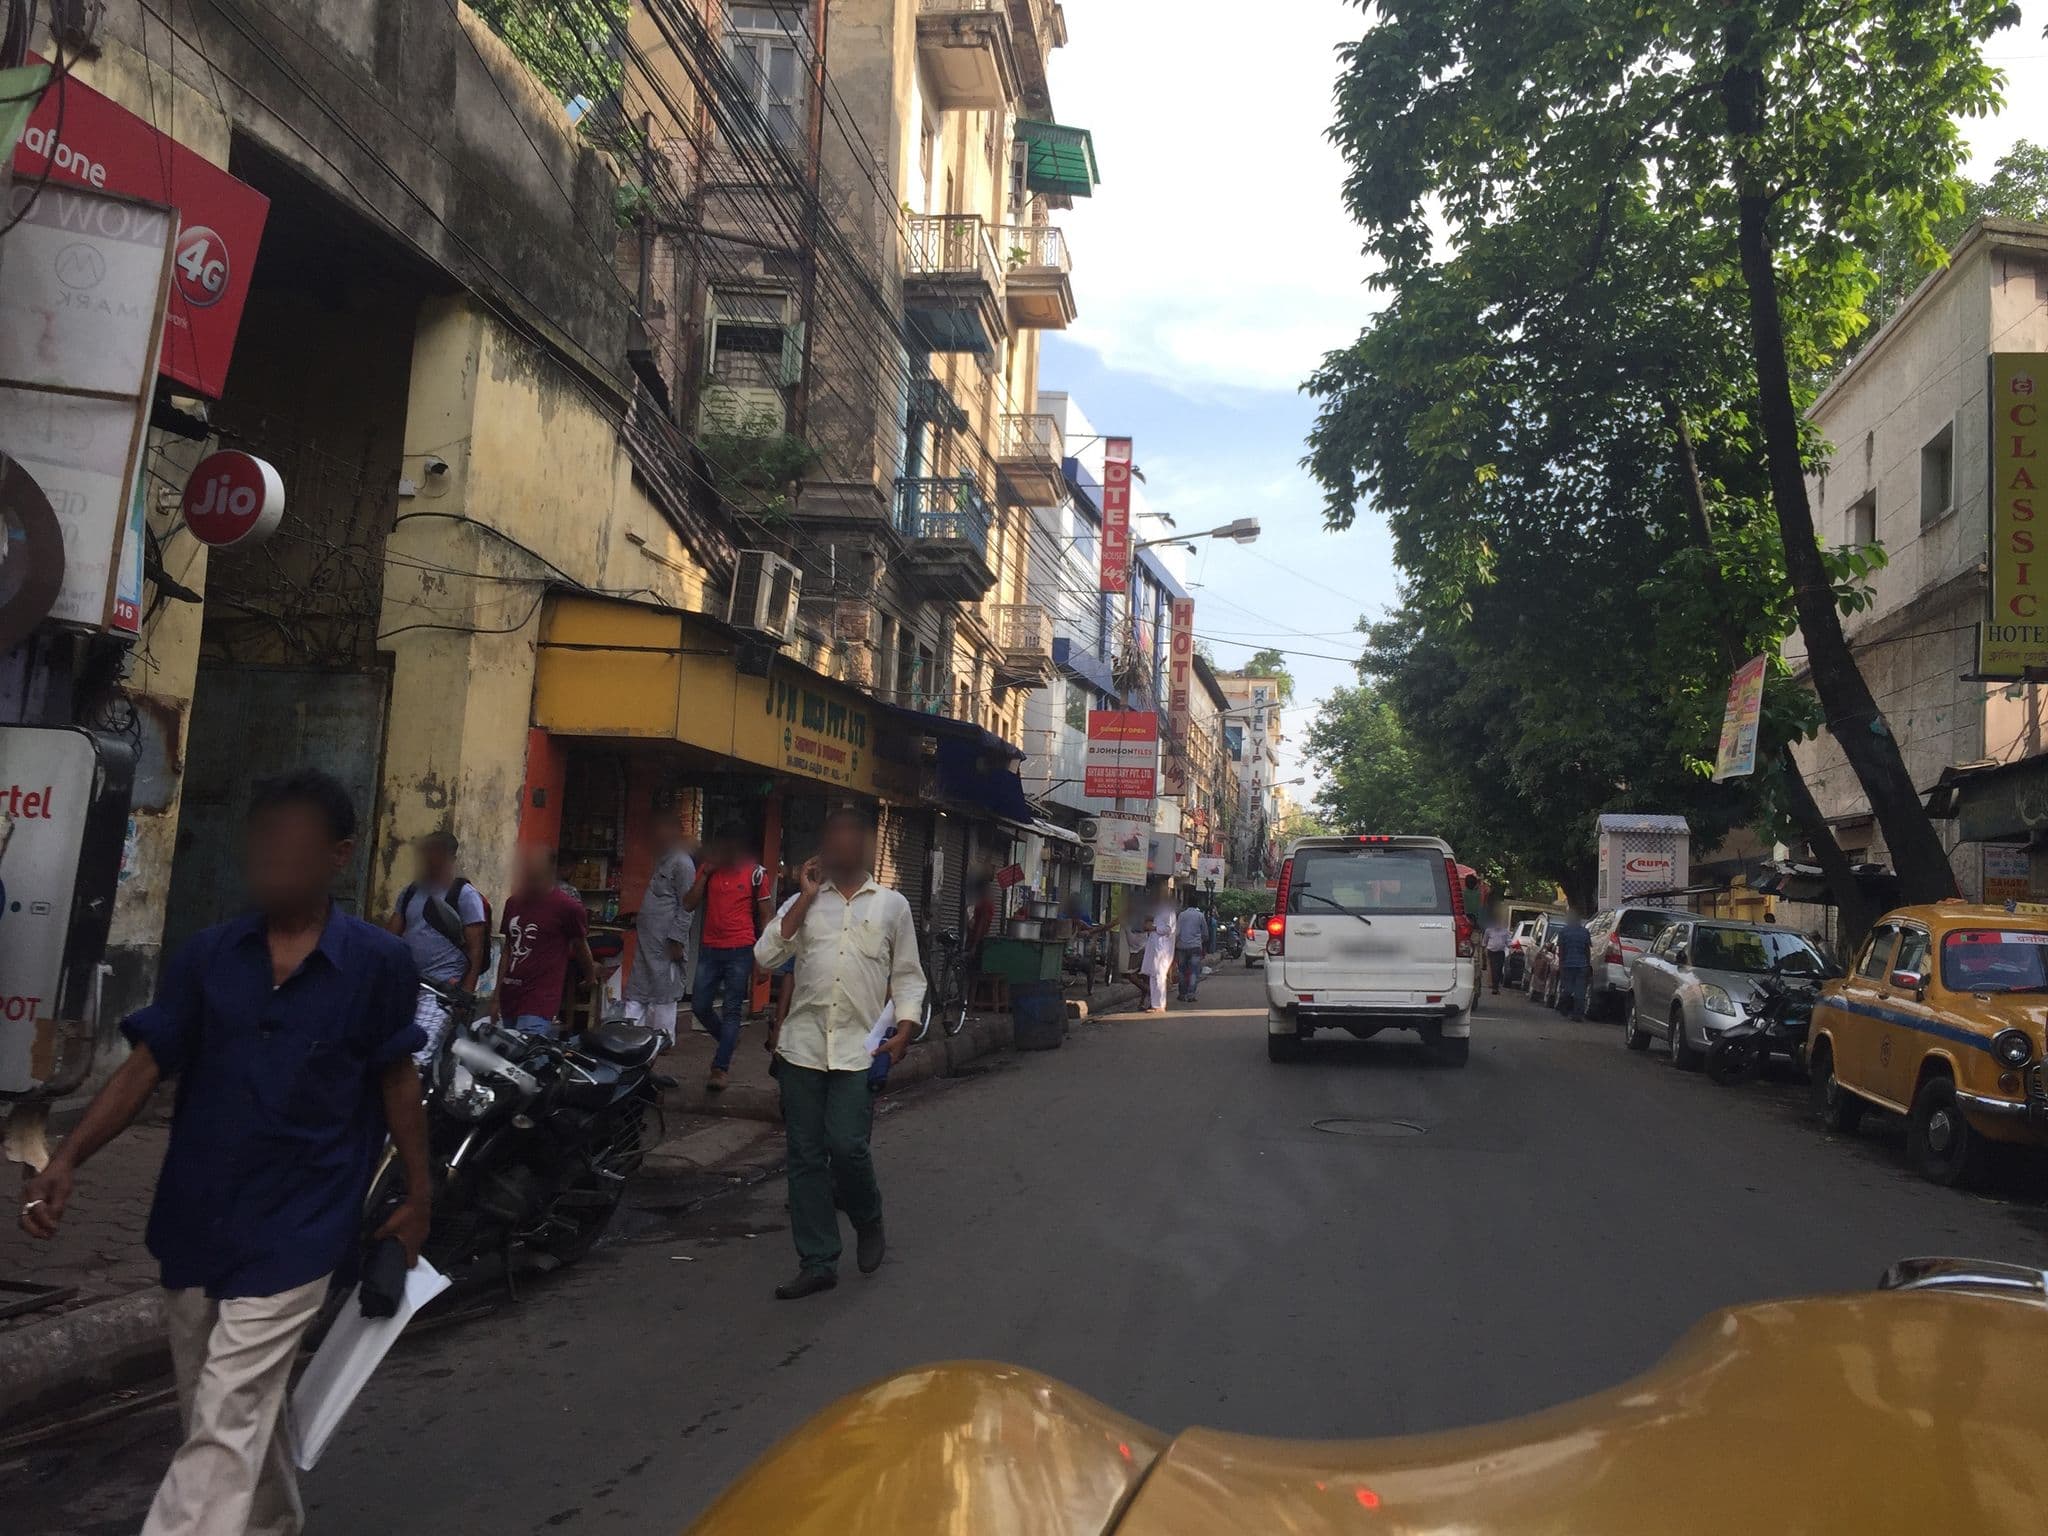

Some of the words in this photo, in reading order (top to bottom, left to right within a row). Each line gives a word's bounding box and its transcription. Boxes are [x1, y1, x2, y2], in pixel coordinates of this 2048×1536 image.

[16, 127, 107, 188] afone
[177, 239, 226, 292] 4G
[191, 474, 257, 516] Jio
[1106, 445, 1129, 548] HOTEL
[2009, 403, 2037, 618] CLASSIC
[1988, 625, 2048, 642] HOTE
[1170, 604, 1191, 740] HOTEL
[1096, 747, 1134, 755] JOHNSON
[1128, 727, 1146, 735] OPEN
[1637, 859, 1670, 868] RUPA
